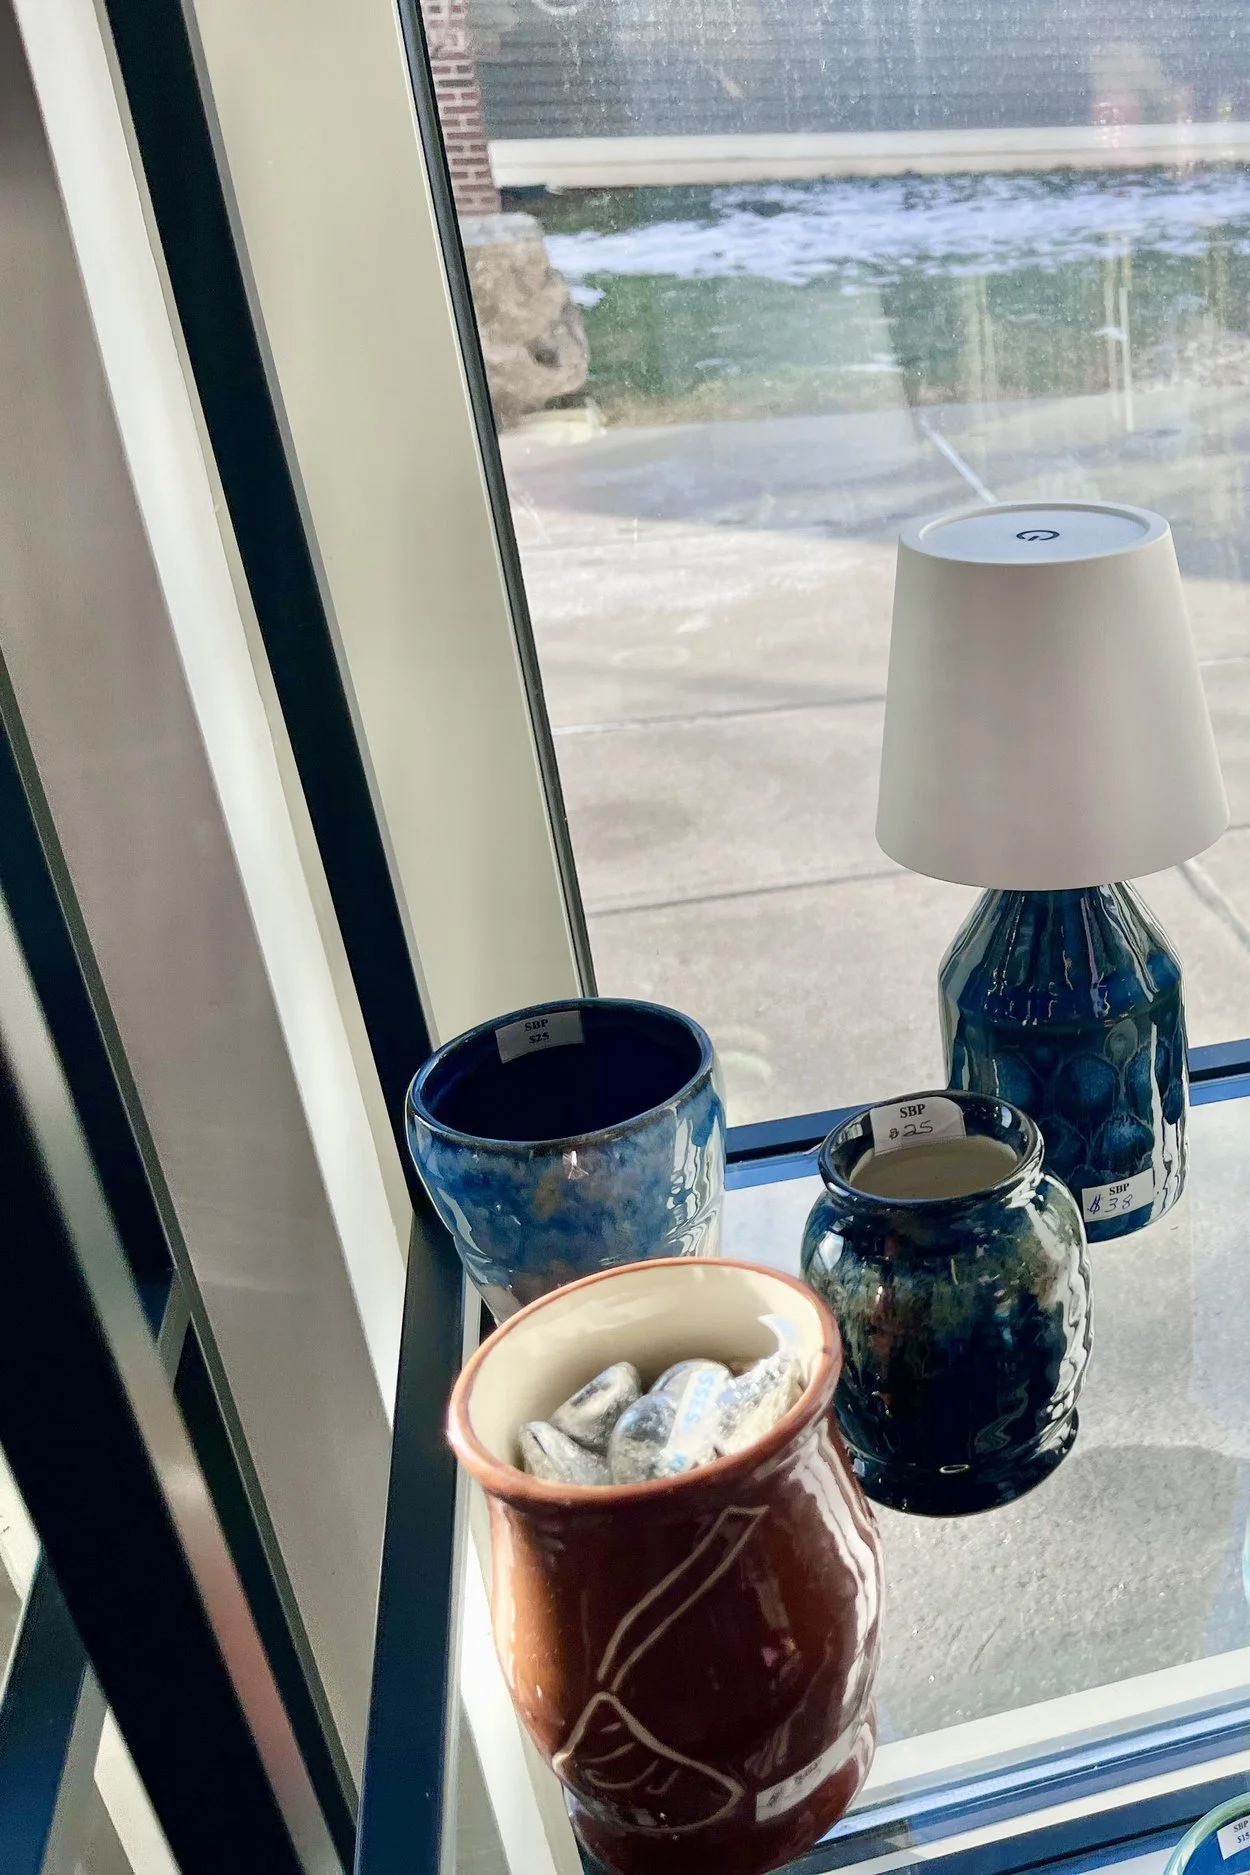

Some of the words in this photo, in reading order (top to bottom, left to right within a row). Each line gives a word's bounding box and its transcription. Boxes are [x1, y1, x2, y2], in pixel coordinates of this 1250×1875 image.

[524, 1019, 549, 1032] SBP
[528, 1032, 550, 1044] $25
[900, 1103, 926, 1118] SBP
[1109, 1183, 1130, 1196] SBP
[1233, 1820, 1249, 1832] SBP
